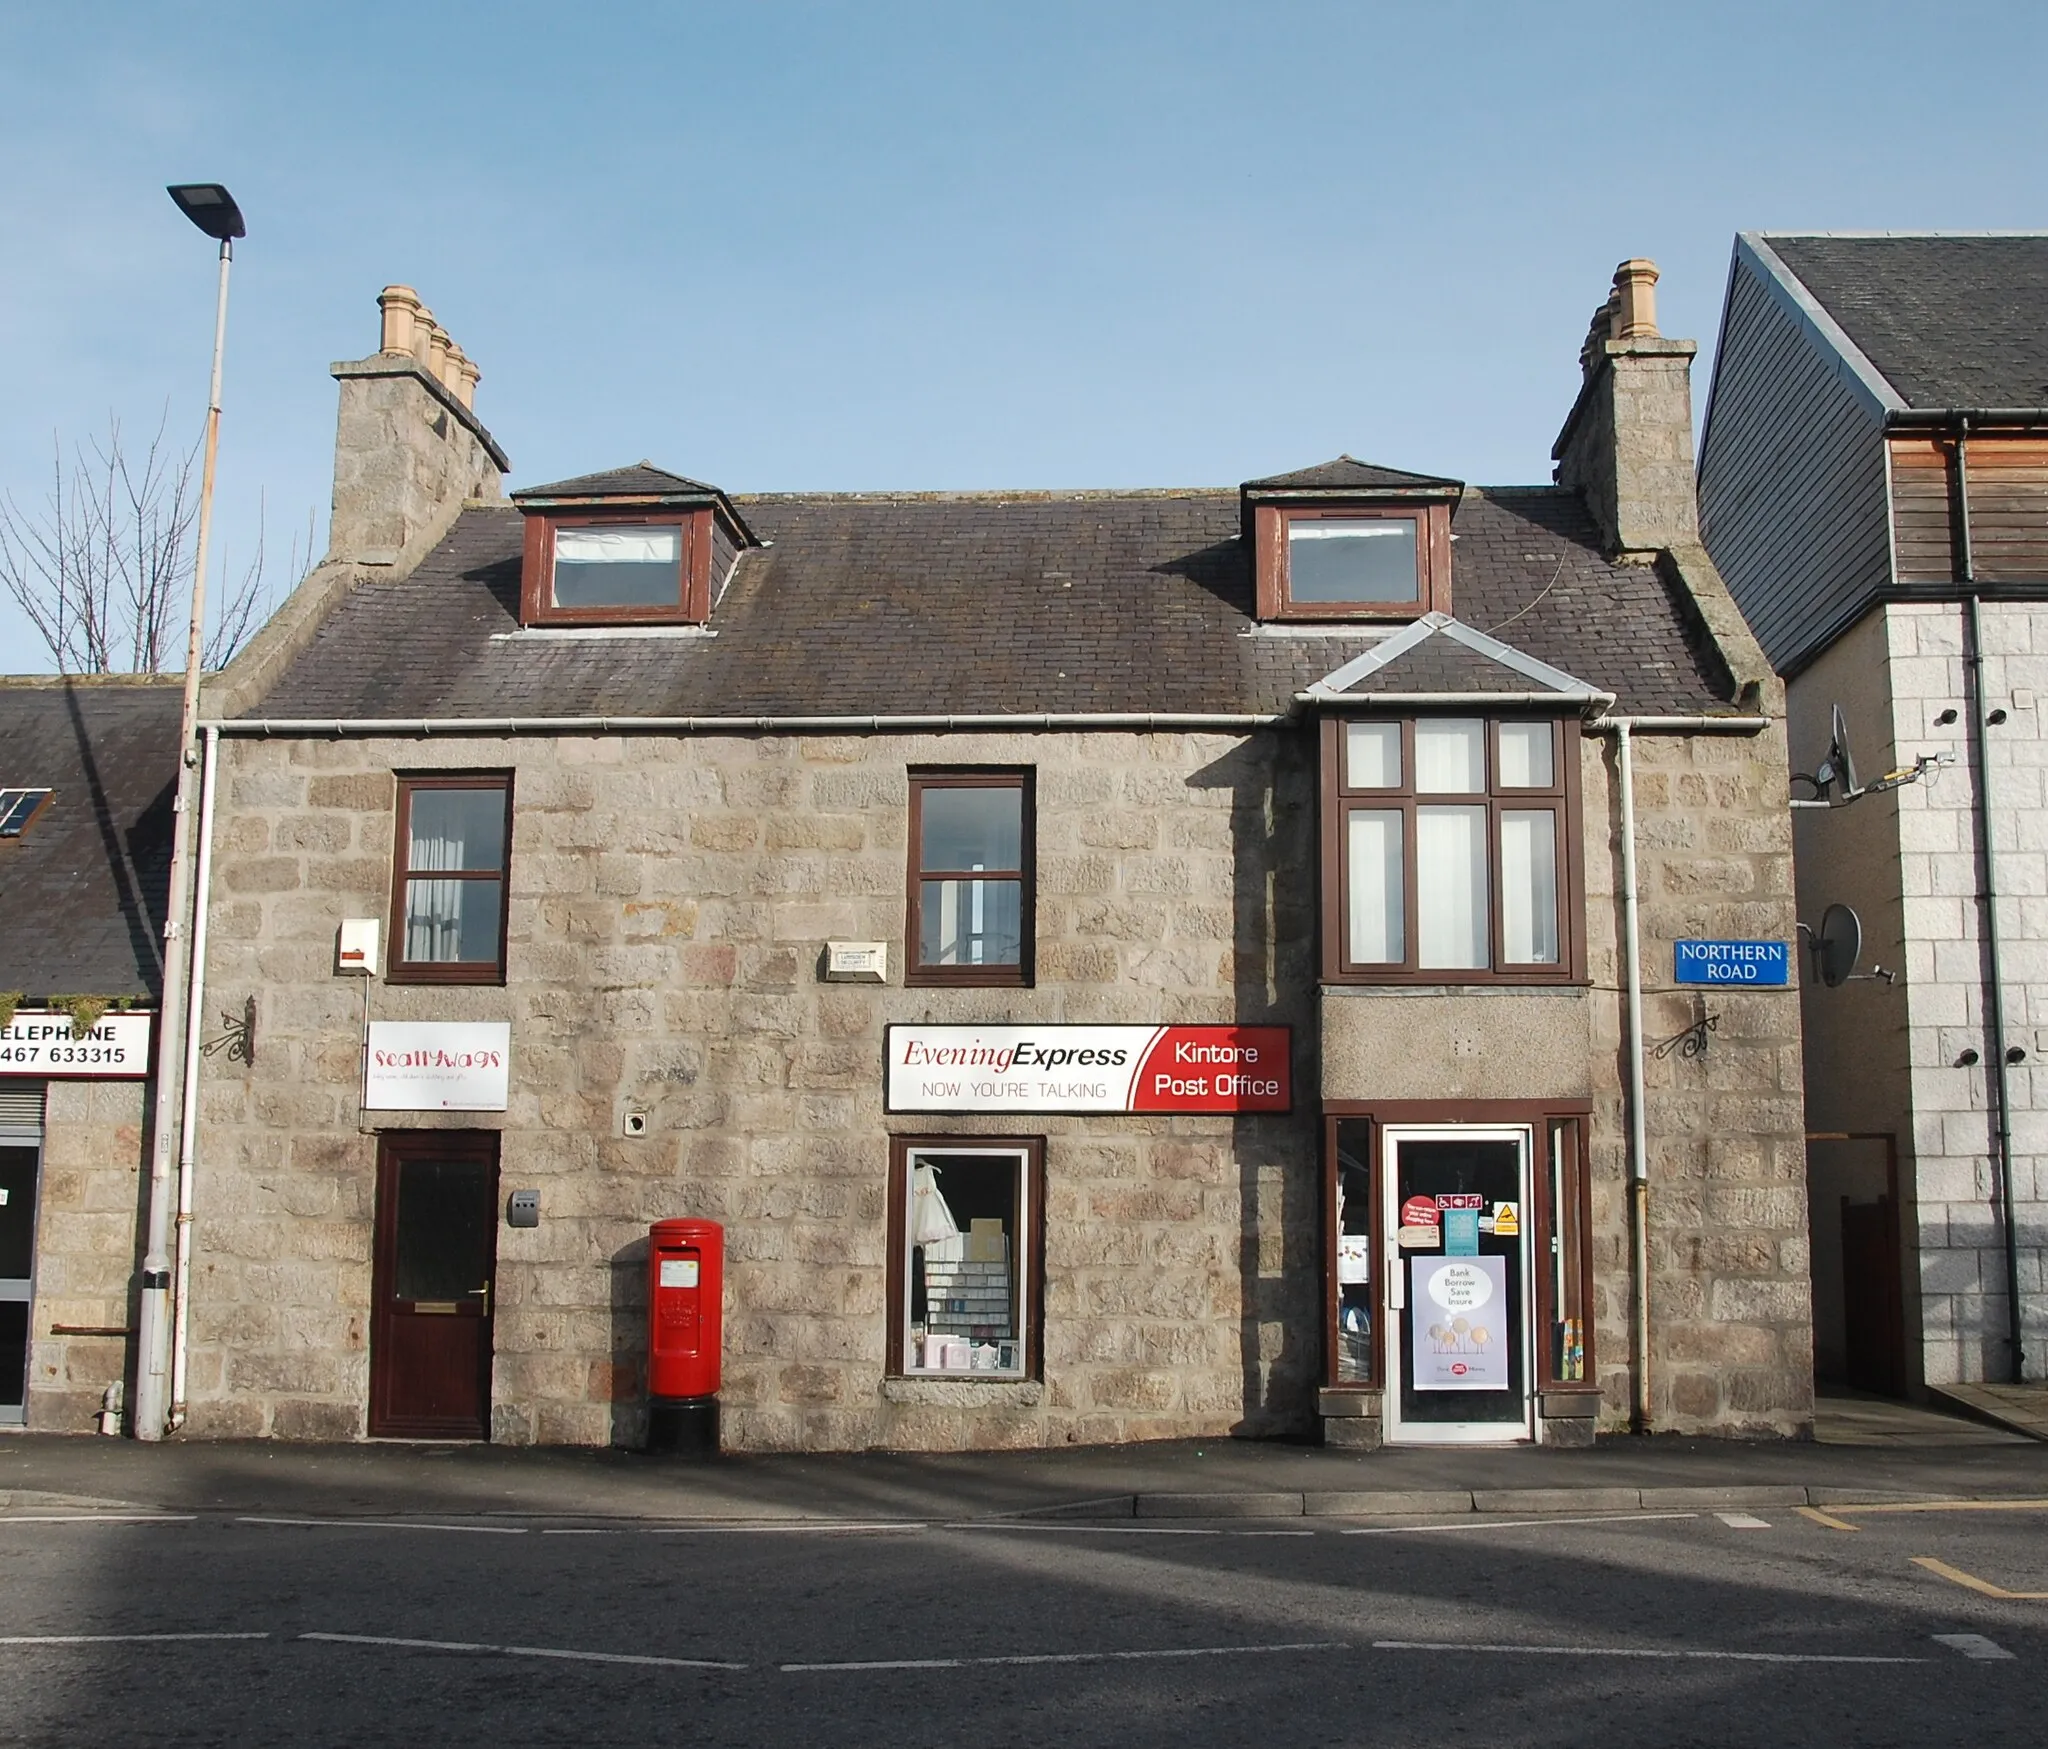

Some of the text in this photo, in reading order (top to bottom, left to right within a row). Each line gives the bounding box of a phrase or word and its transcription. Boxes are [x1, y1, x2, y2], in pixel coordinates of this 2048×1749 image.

[1681, 944, 1782, 961] NORTHERN
[1707, 963, 1757, 979] ROAD
[0, 1047, 126, 1063] 467 633315
[1174, 1041, 1259, 1064] Kintore
[922, 1082, 1108, 1099] NOW YOU'RE TALKING
[1155, 1074, 1280, 1097] Post Office
[1450, 1268, 1470, 1277] Bank
[1444, 1278, 1475, 1287] Borrow
[1450, 1287, 1470, 1296] Save
[1448, 1297, 1473, 1305] Insure
